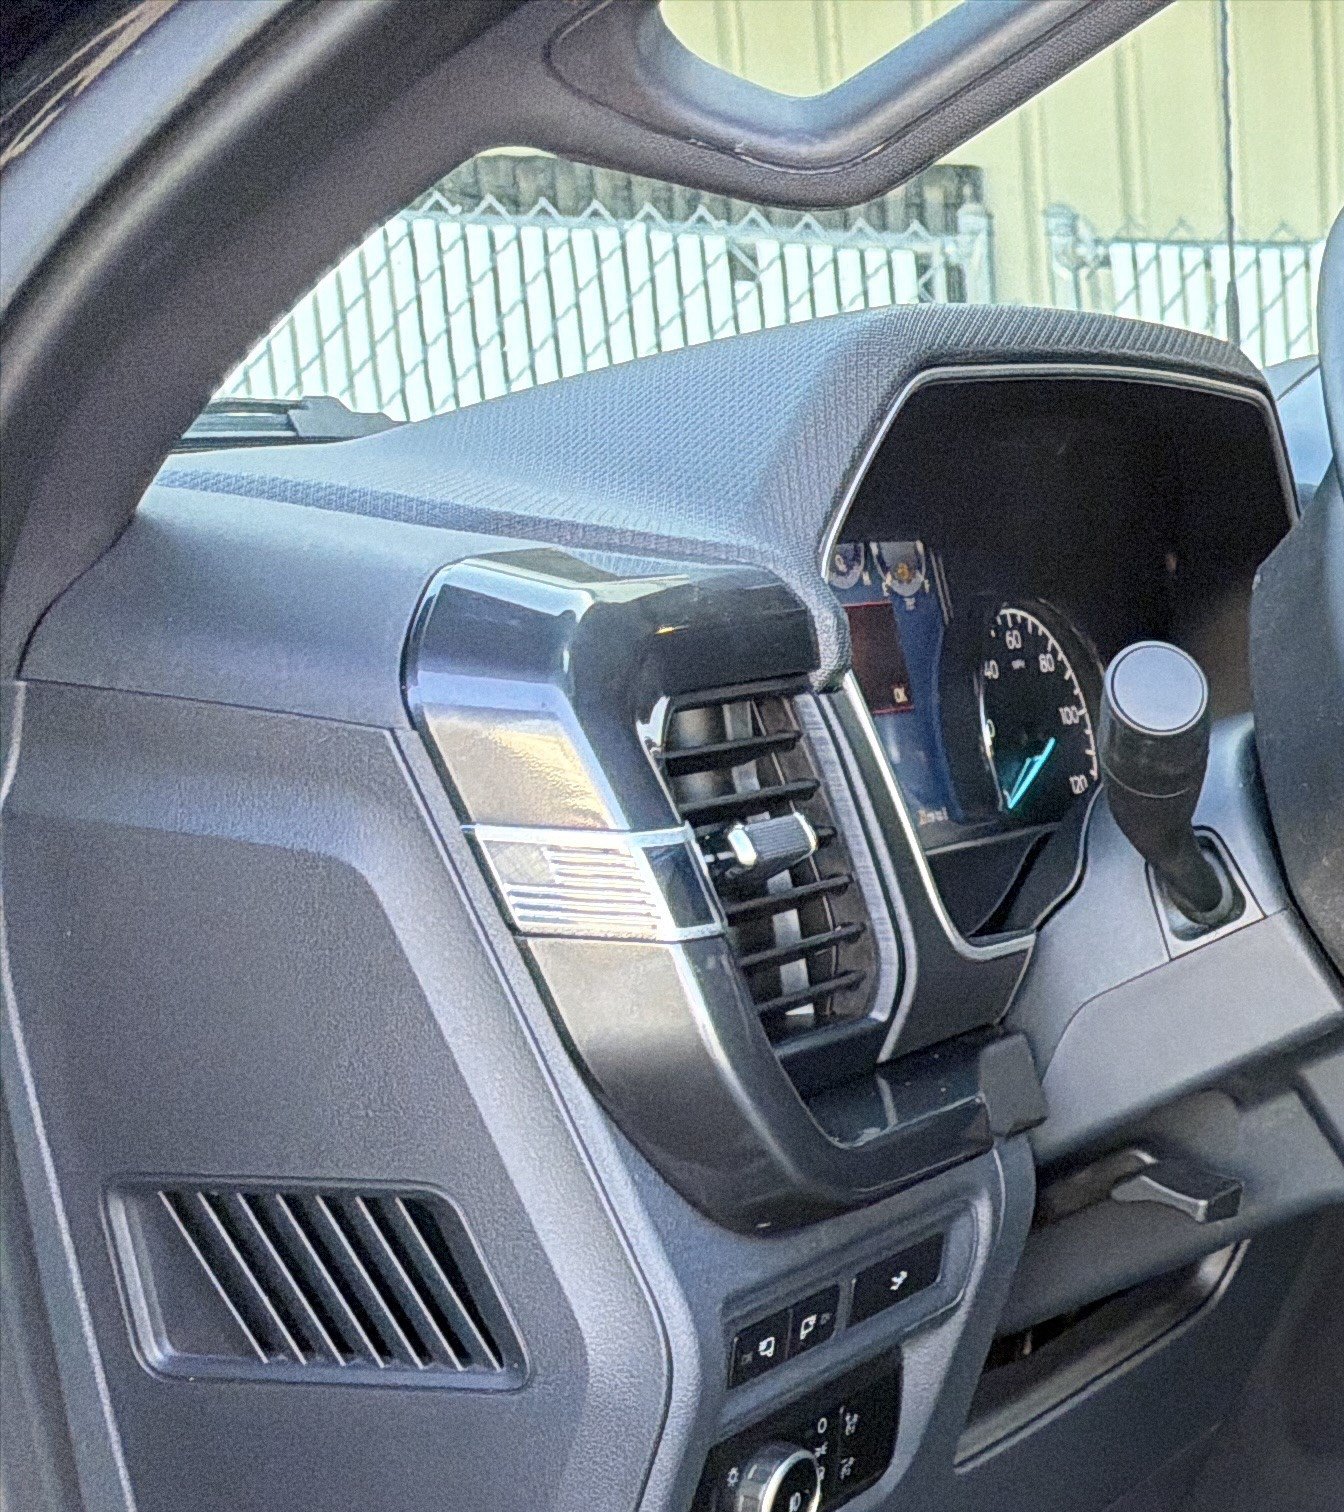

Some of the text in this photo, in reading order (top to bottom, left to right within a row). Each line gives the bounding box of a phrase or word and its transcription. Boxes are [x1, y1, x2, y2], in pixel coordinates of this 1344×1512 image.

[1006, 630, 1022, 649] 60
[1059, 705, 1080, 725] 100
[1069, 775, 1088, 794] 120
